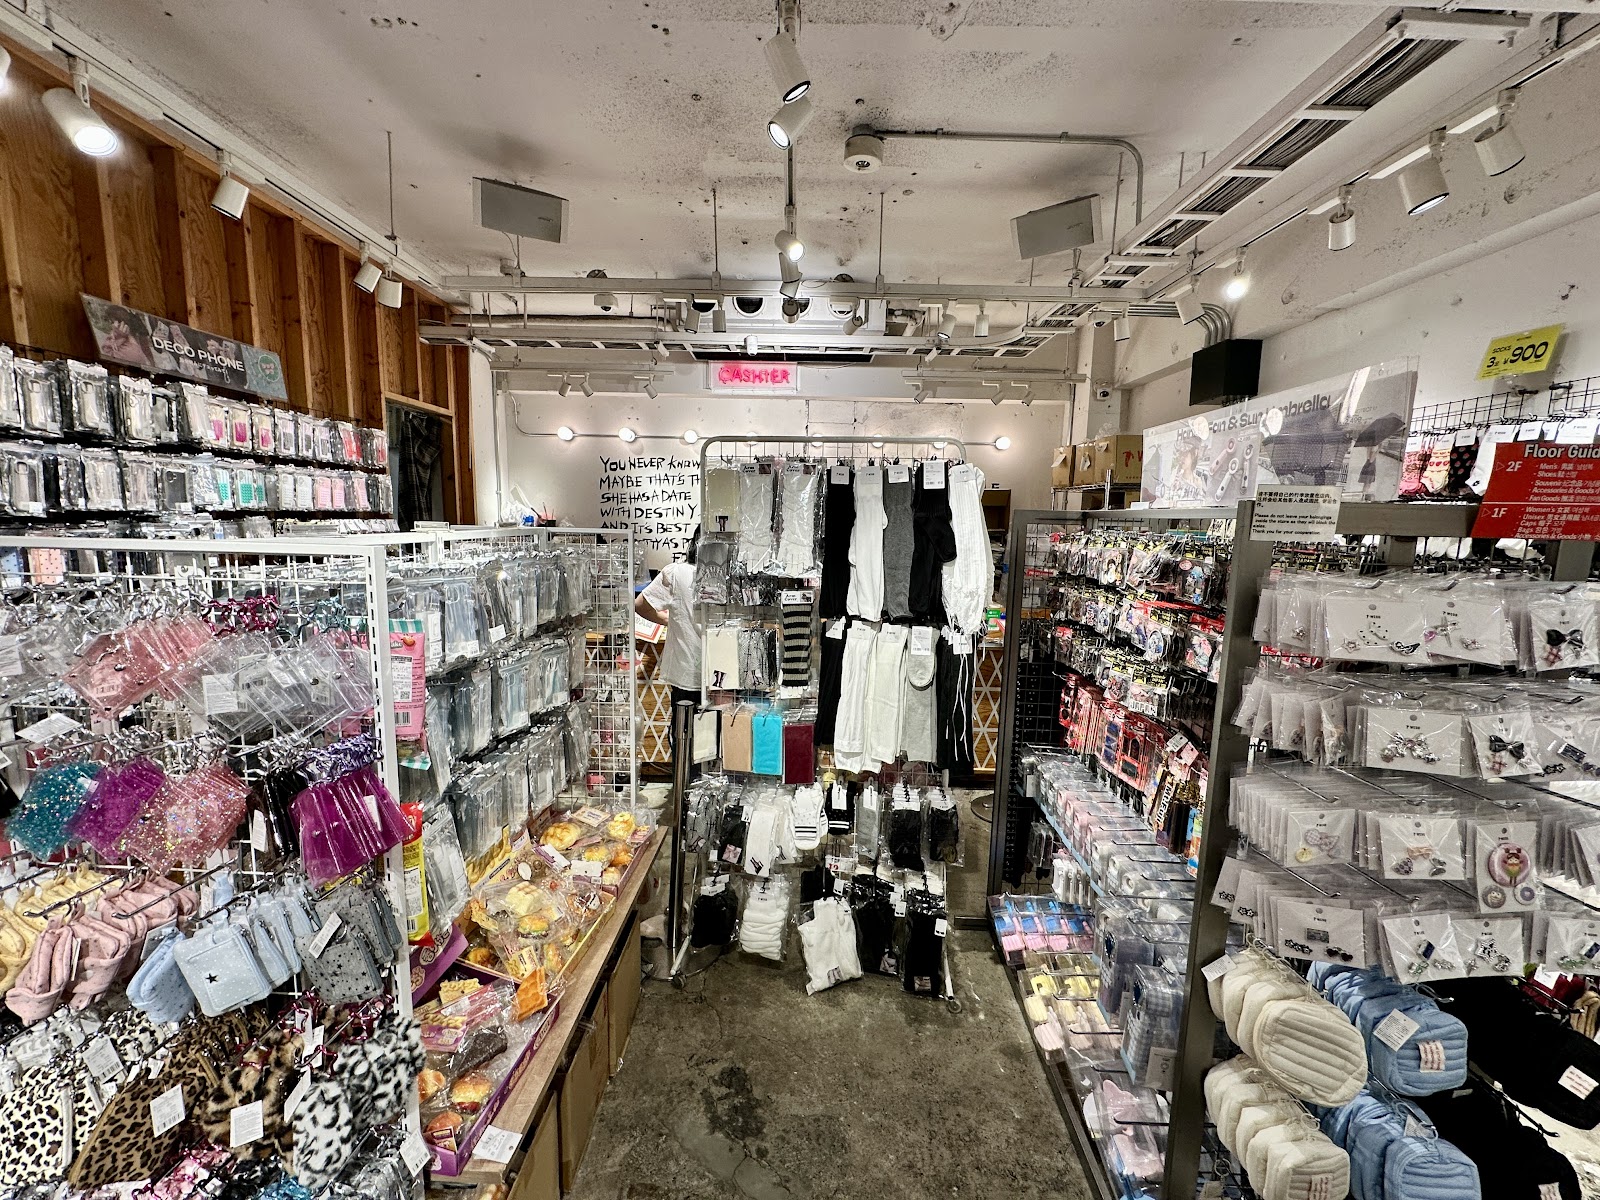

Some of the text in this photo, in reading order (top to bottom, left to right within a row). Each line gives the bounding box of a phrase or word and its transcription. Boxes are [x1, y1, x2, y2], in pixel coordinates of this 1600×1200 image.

[152, 337, 195, 358] DECO
[198, 350, 244, 372] PHONE
[1492, 345, 1512, 354] SOCKS
[718, 367, 790, 384] CASHIER
[1228, 416, 1238, 430] &
[1240, 412, 1264, 428] Sun
[1524, 444, 1564, 458] Floor
[600, 456, 626, 472] YOU
[628, 457, 665, 470] NEVER
[1506, 461, 1523, 472] 2F
[600, 475, 642, 490] MAYBE
[646, 473, 684, 486] THAT'S
[600, 489, 692, 506] SHE HAS A DATE
[600, 506, 630, 519] WITH
[1491, 508, 1508, 517] 1F
[601, 521, 628, 529] AND
[656, 522, 691, 534] BEST
